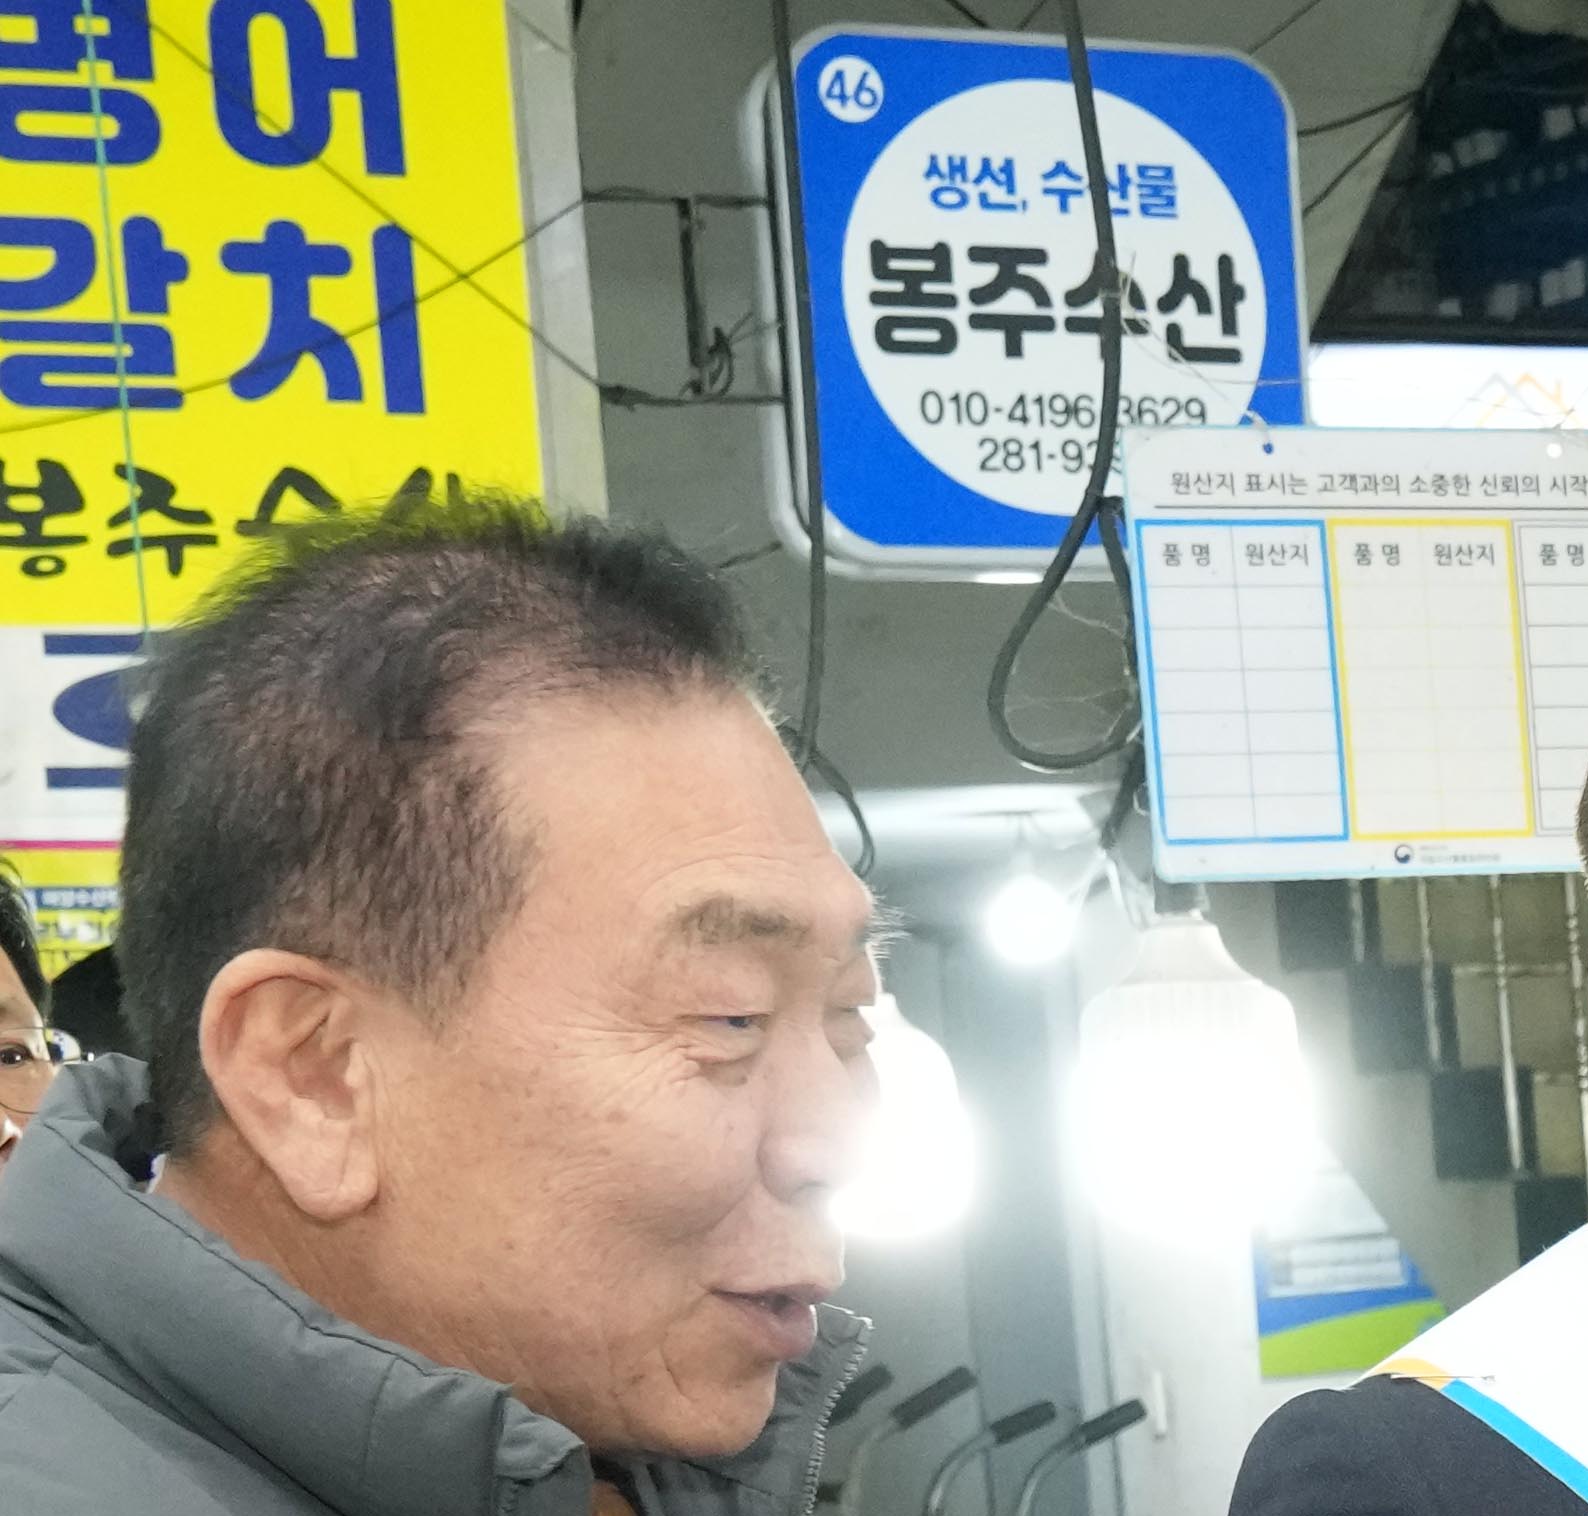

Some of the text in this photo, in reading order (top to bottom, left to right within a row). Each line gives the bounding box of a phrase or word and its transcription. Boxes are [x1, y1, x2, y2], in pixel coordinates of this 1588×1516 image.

[825, 69, 878, 109] 46
[1042, 160, 1179, 220] 수산물
[0, 216, 426, 414] 갈치
[868, 239, 1248, 366] 봉주수산
[920, 390, 1208, 428] 010-41963629
[1171, 472, 1236, 498] 원산지
[1245, 472, 1309, 497] 표시는
[1317, 472, 1402, 497] 고객과의
[1408, 472, 1471, 498] 소중한
[1480, 472, 1542, 498] 신뢰의
[1245, 541, 1310, 566] 원산지
[1434, 541, 1496, 566] 원산지
